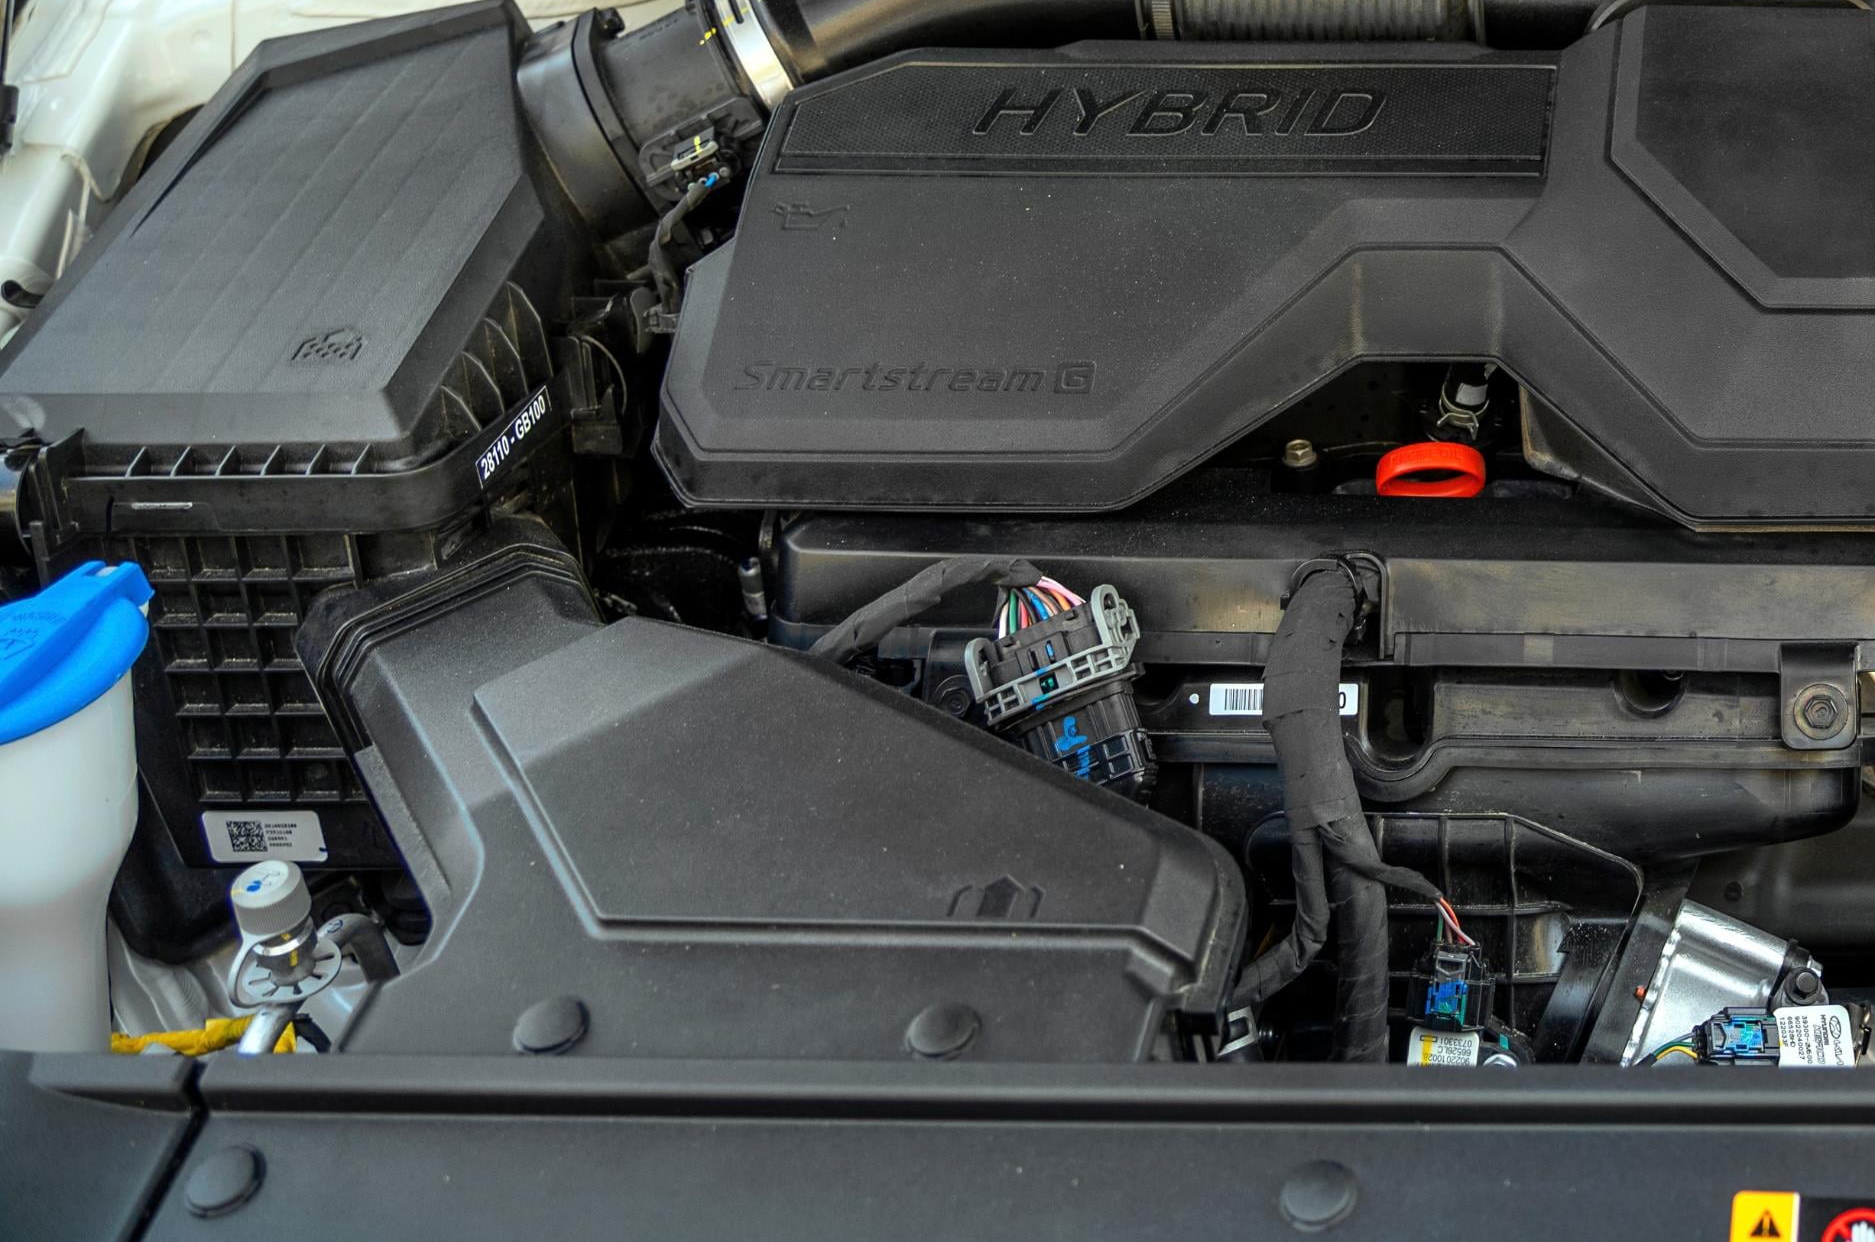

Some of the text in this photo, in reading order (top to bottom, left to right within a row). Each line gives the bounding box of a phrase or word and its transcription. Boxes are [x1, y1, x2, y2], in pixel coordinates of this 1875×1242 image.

[971, 88, 1388, 136] HYBRID
[734, 360, 1096, 394] Smartstream G
[480, 434, 510, 480] 28110
[514, 394, 547, 441] GB100
